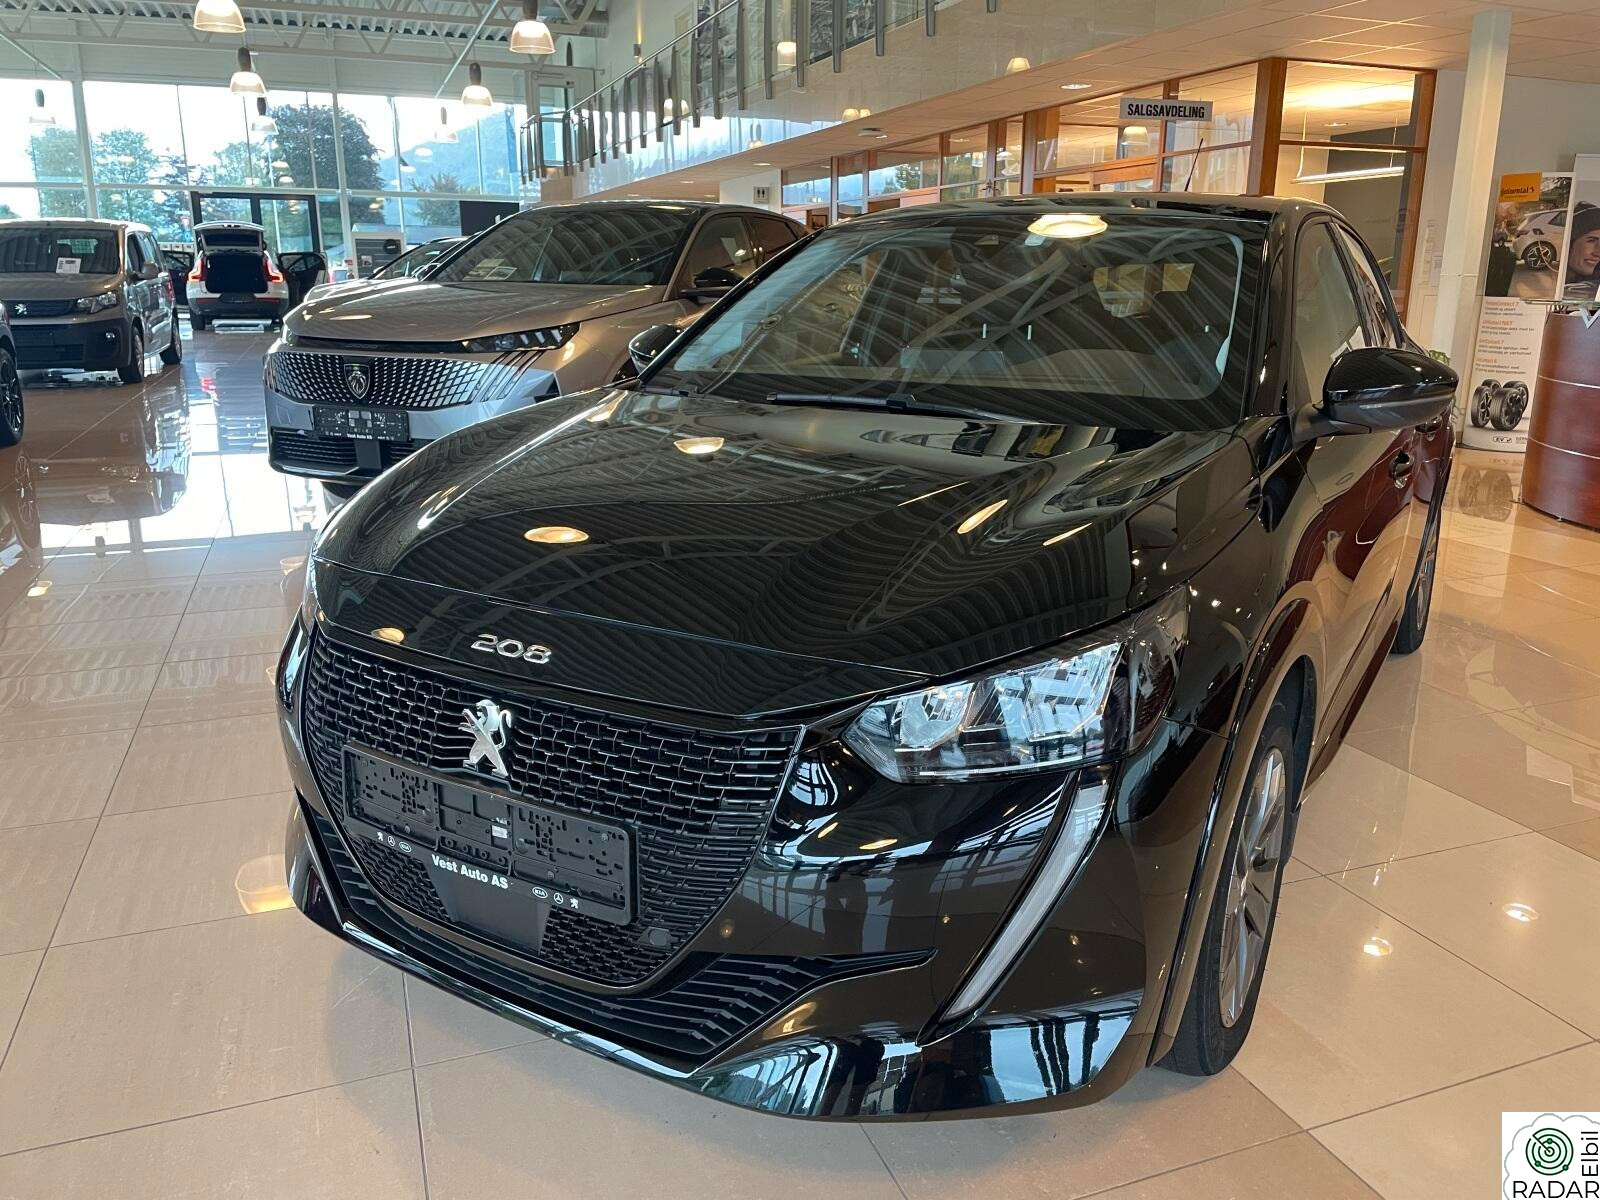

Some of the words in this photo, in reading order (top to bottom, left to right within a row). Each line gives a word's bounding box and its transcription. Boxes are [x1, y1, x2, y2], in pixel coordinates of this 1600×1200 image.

[1127, 103, 1205, 118] SALGSAVDELING
[470, 633, 552, 664] 208
[431, 854, 458, 873] Vest
[460, 864, 489, 883] Auto
[491, 874, 509, 890] AS
